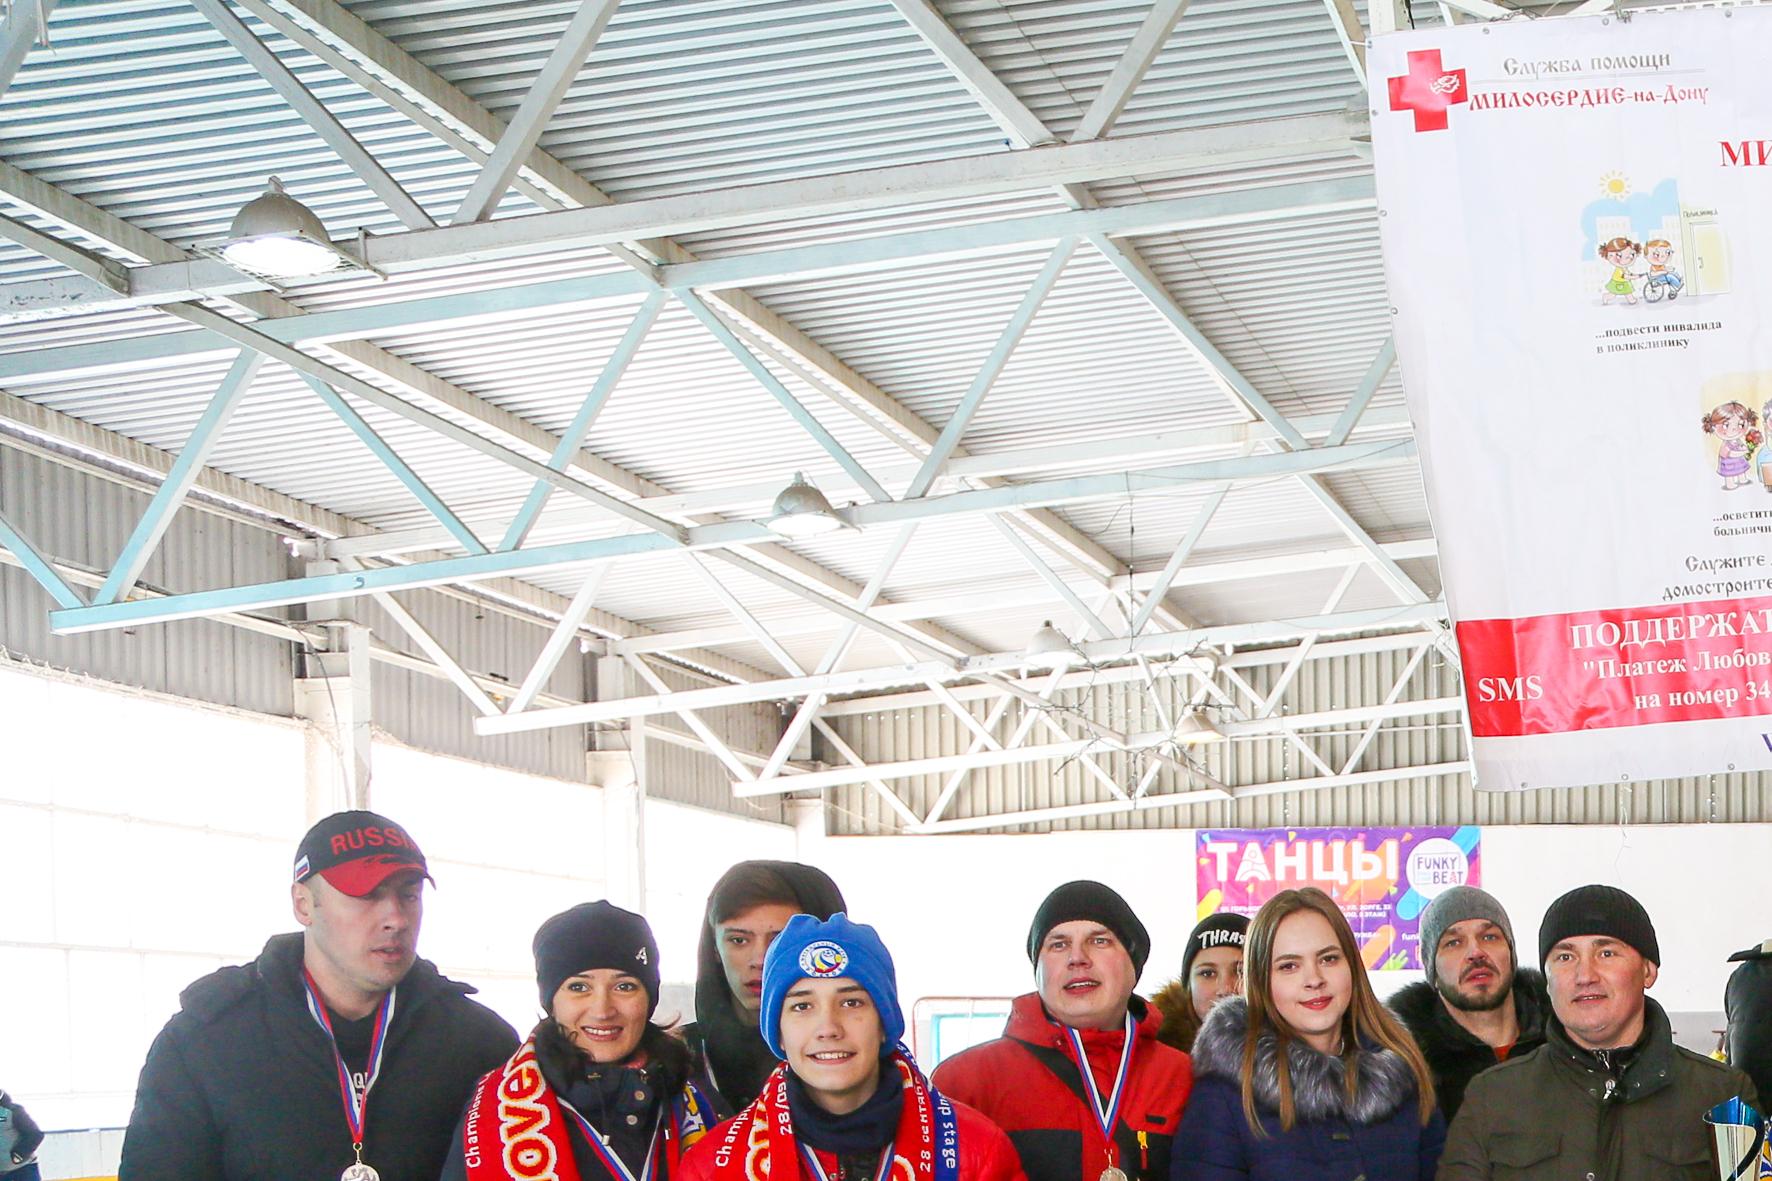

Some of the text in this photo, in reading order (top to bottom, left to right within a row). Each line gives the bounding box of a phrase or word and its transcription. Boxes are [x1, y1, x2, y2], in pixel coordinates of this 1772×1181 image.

[1595, 319, 1722, 339] ...подвести инвалида
[1596, 338, 1690, 354] в поликлинику
[1478, 674, 1545, 703] SMS
[1635, 692, 1662, 710] на
[1668, 684, 1739, 708] номер
[1206, 840, 1400, 885] ТАНЦЫ
[1417, 856, 1458, 870] FUNKY
[1433, 871, 1464, 885] BEAT
